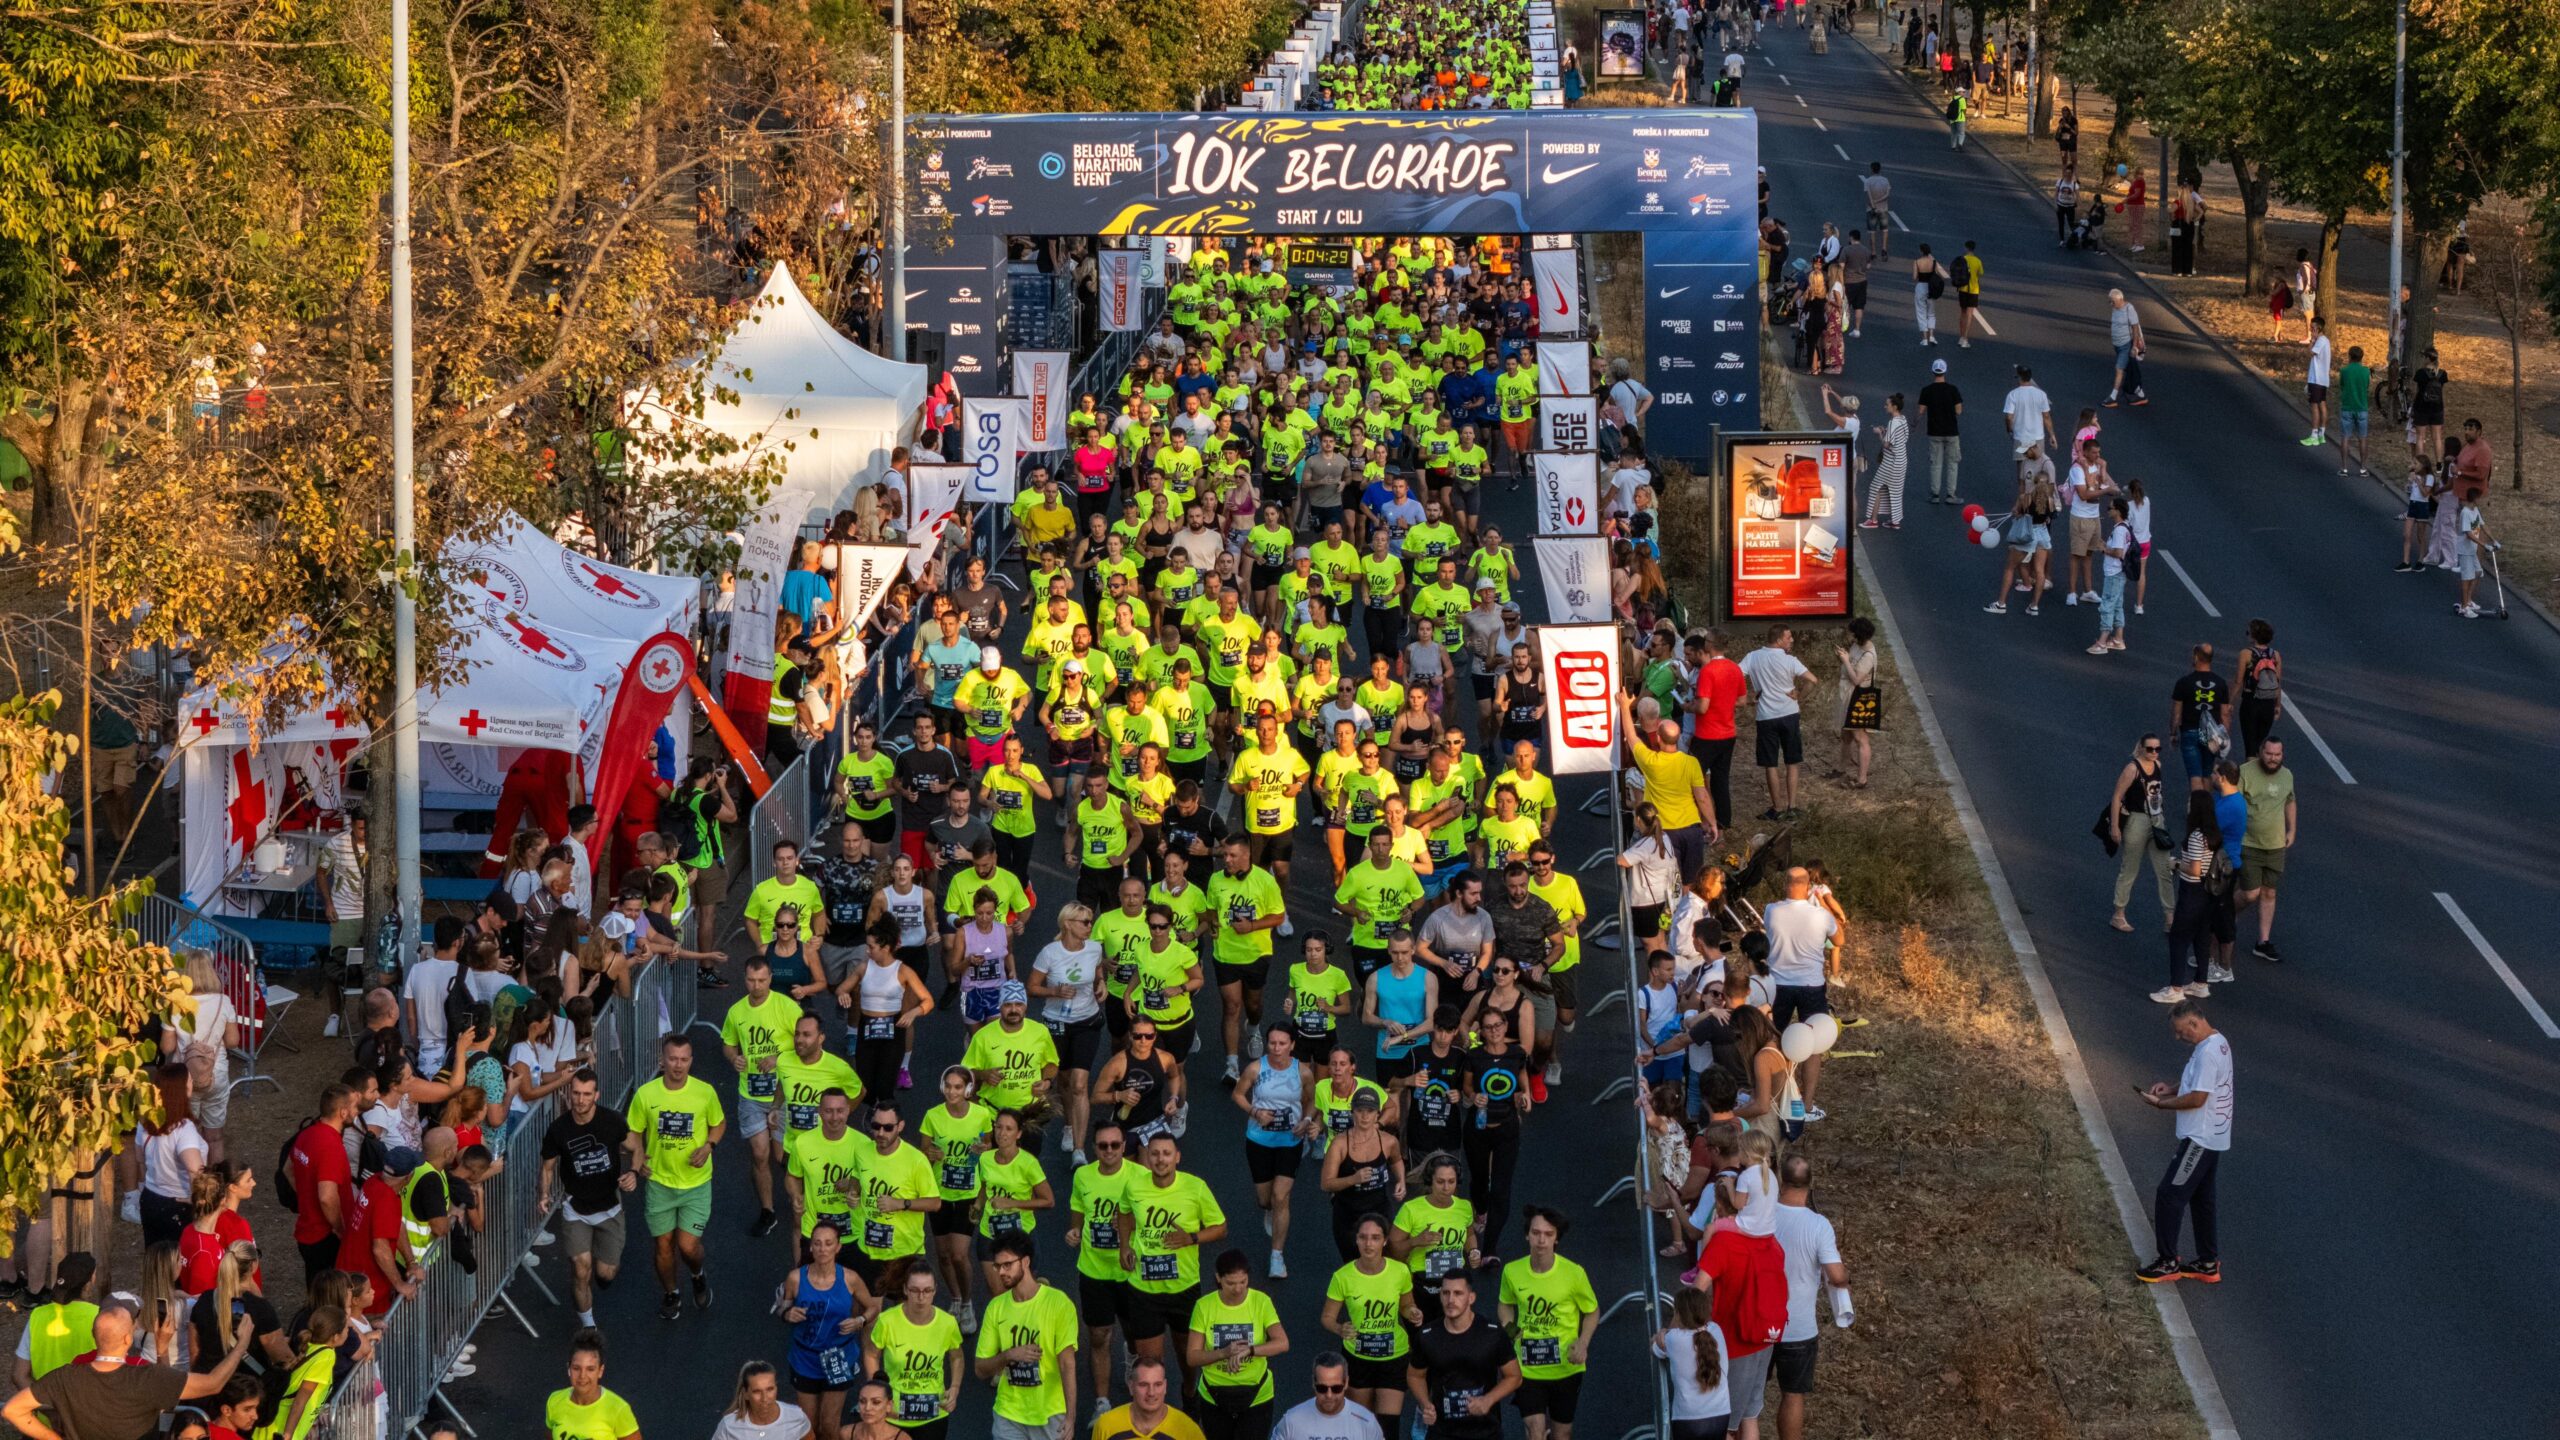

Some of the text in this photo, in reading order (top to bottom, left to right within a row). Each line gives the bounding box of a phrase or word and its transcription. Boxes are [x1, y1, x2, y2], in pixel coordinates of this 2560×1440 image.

[1073, 144, 1135, 158] BELGRADE
[1542, 143, 1600, 154] POWERED BY
[1073, 158, 1142, 172] MARATHON
[1167, 131, 1513, 195] 10K BELGRADE
[1073, 172, 1111, 186] EVENT
[1277, 209, 1318, 225] START
[1337, 209, 1362, 225] CILJ
[1292, 250, 1348, 264] 0:04:29
[1115, 257, 1127, 325] SPORT TIME
[952, 365, 982, 373] ПОШТА
[1411, 379, 1425, 387] 10K
[1508, 387, 1521, 396] 10K
[1034, 365, 1047, 440] SPORT TIME
[1552, 413, 1569, 451] WER
[975, 413, 1001, 492] rosa
[1273, 442, 1289, 452] 10K
[1827, 452, 1838, 462] 12
[1175, 462, 1191, 473] 10K
[1547, 471, 1562, 541] COMTRA
[1745, 531, 1779, 540] PLATITE
[755, 535, 780, 552] ПРВА
[1745, 540, 1780, 548] NA RATE
[748, 545, 782, 564] ПОМОЋ
[1371, 575, 1388, 585] 10K
[1488, 568, 1502, 578] 10K
[1038, 587, 1050, 597] 10
[1443, 602, 1462, 614] 10K
[1051, 640, 1072, 652] 10K
[1223, 637, 1243, 650] 10K
[1162, 663, 1174, 677] 10
[1081, 674, 1096, 686] 0K
[986, 686, 1008, 700] 10K
[1248, 697, 1259, 711] 10
[1178, 708, 1198, 721] 10K
[489, 716, 516, 726] Црвени
[536, 720, 564, 731] Београд
[489, 726, 502, 734] Red
[503, 728, 523, 736] Cross
[534, 731, 565, 740] Belgrade
[1122, 728, 1143, 743] 10K
[1261, 769, 1284, 785] 10K
[1092, 825, 1116, 836] 10K
[1496, 839, 1519, 852] 10K
[1172, 913, 1187, 926] 0K
[1143, 973, 1165, 991] 10K
[1300, 992, 1318, 1007] 10
[749, 1026, 776, 1046] 10K
[1004, 1049, 1035, 1070] 10K
[792, 1083, 823, 1104] 10K
[1145, 1205, 1181, 1229] 10K
[1438, 1226, 1466, 1247] 10K
[1148, 1263, 1170, 1273] 3493
[1364, 1299, 1396, 1320] 10K
[1527, 1294, 1558, 1316] 10K
[1010, 1325, 1041, 1348] 10K
[1224, 1333, 1244, 1341] JOVANA
[830, 1356, 841, 1376] 3351
[904, 1351, 938, 1371] 10K
